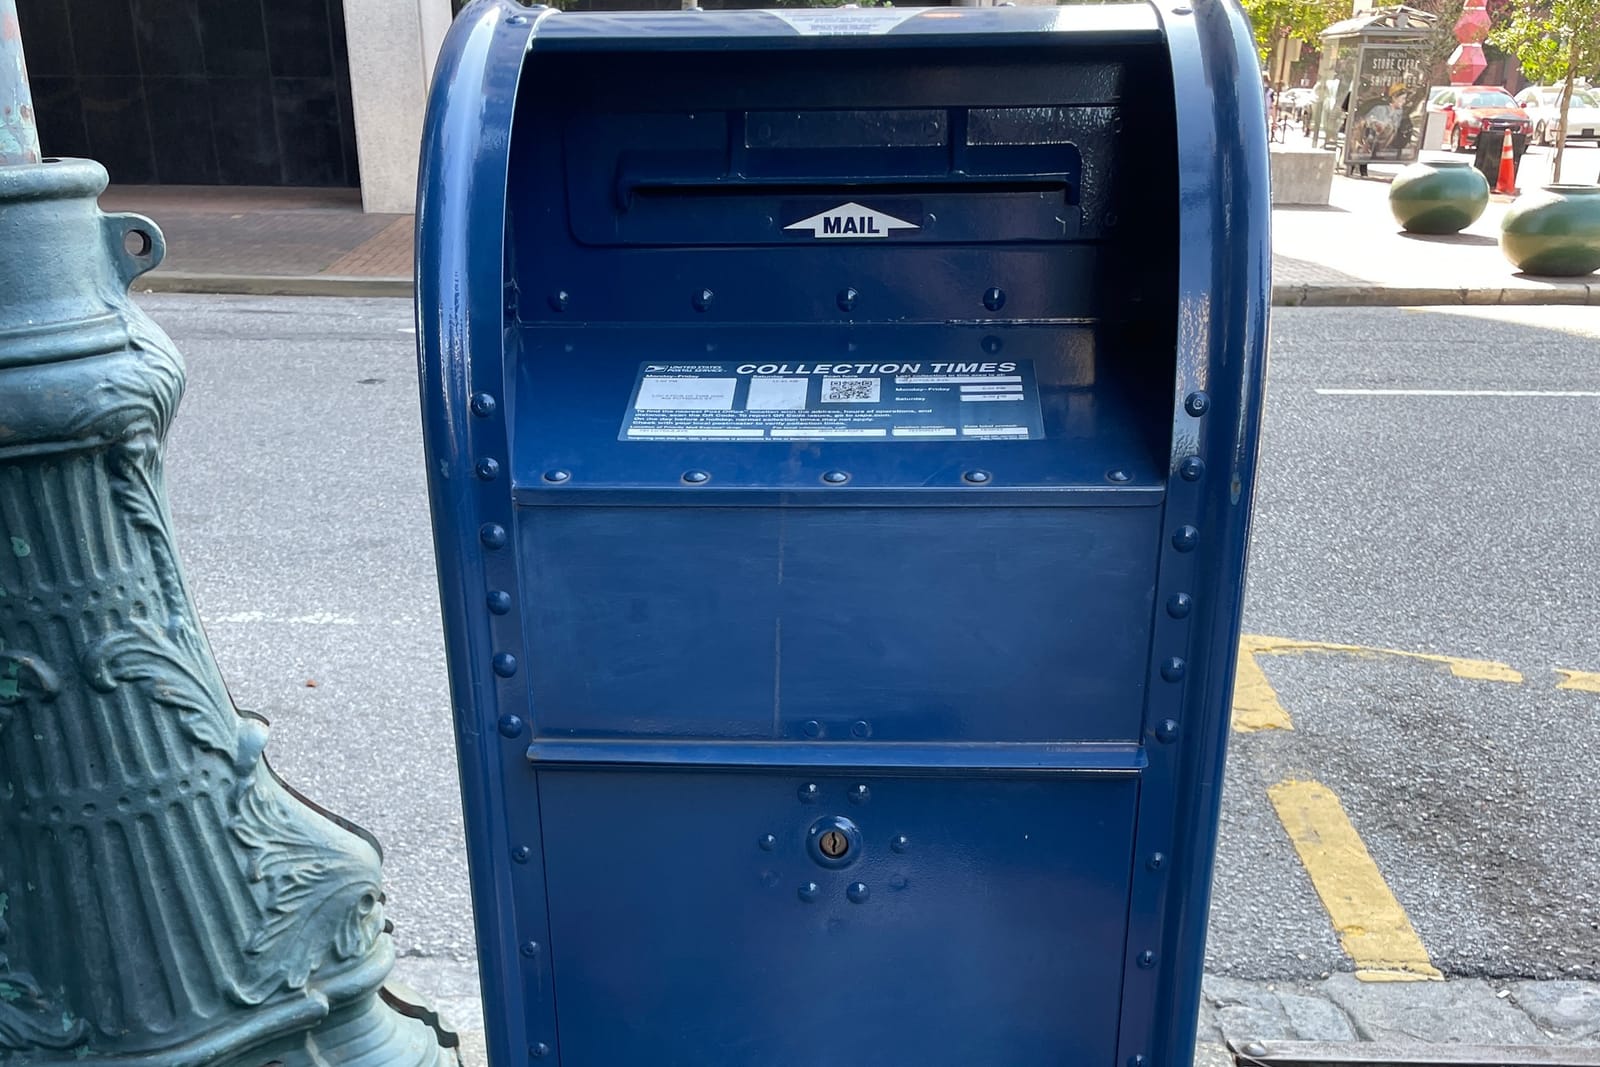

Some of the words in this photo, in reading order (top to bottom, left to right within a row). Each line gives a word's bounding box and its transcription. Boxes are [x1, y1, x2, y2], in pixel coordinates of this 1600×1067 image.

[823, 216, 880, 234] MAIL
[736, 363, 921, 374] COLLECTION
[931, 362, 1017, 373] TIMES
